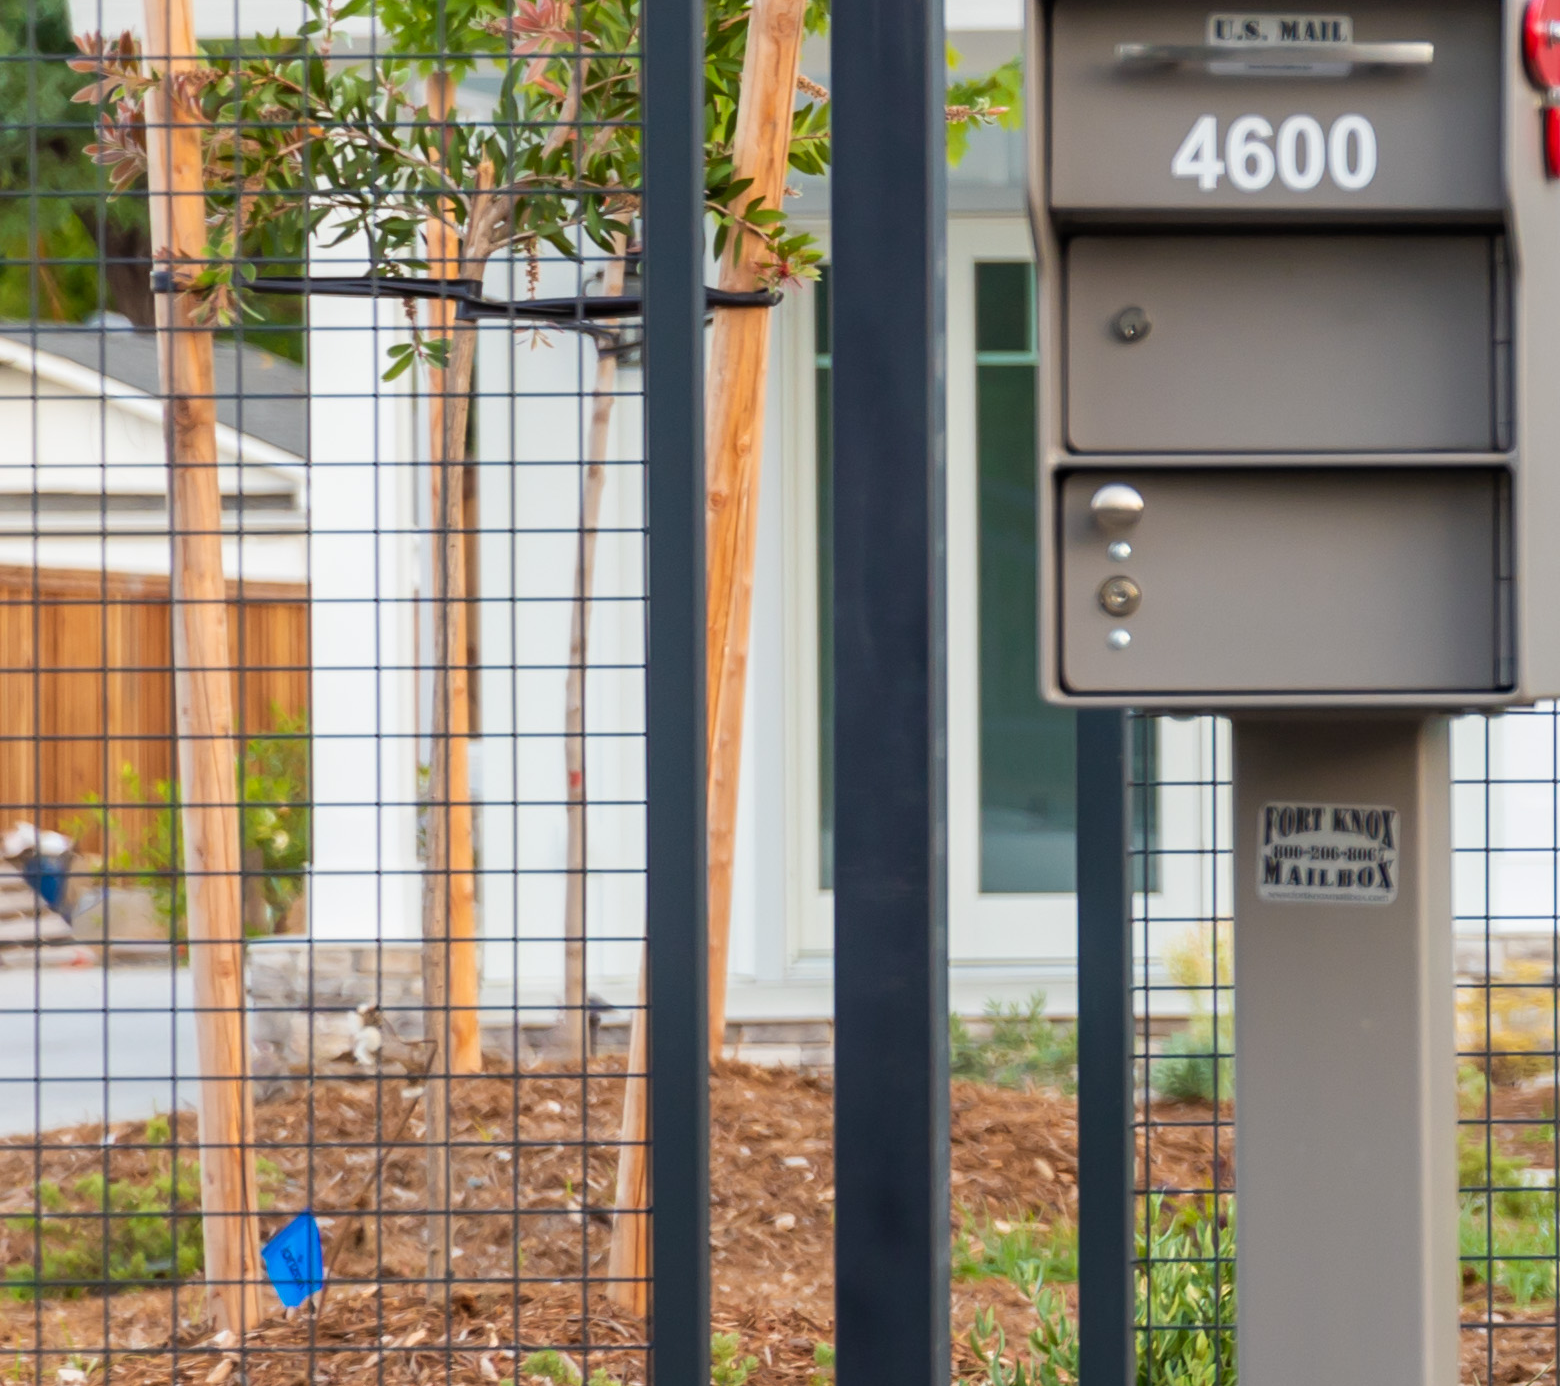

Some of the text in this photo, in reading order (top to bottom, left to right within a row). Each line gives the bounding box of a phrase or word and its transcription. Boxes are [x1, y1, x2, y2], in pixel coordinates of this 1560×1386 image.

[1215, 19, 1348, 42] U.S. MAIL
[1171, 114, 1377, 192] 4600
[1264, 805, 1396, 850] FORT KNOX
[1263, 855, 1394, 892] MAILBOX
